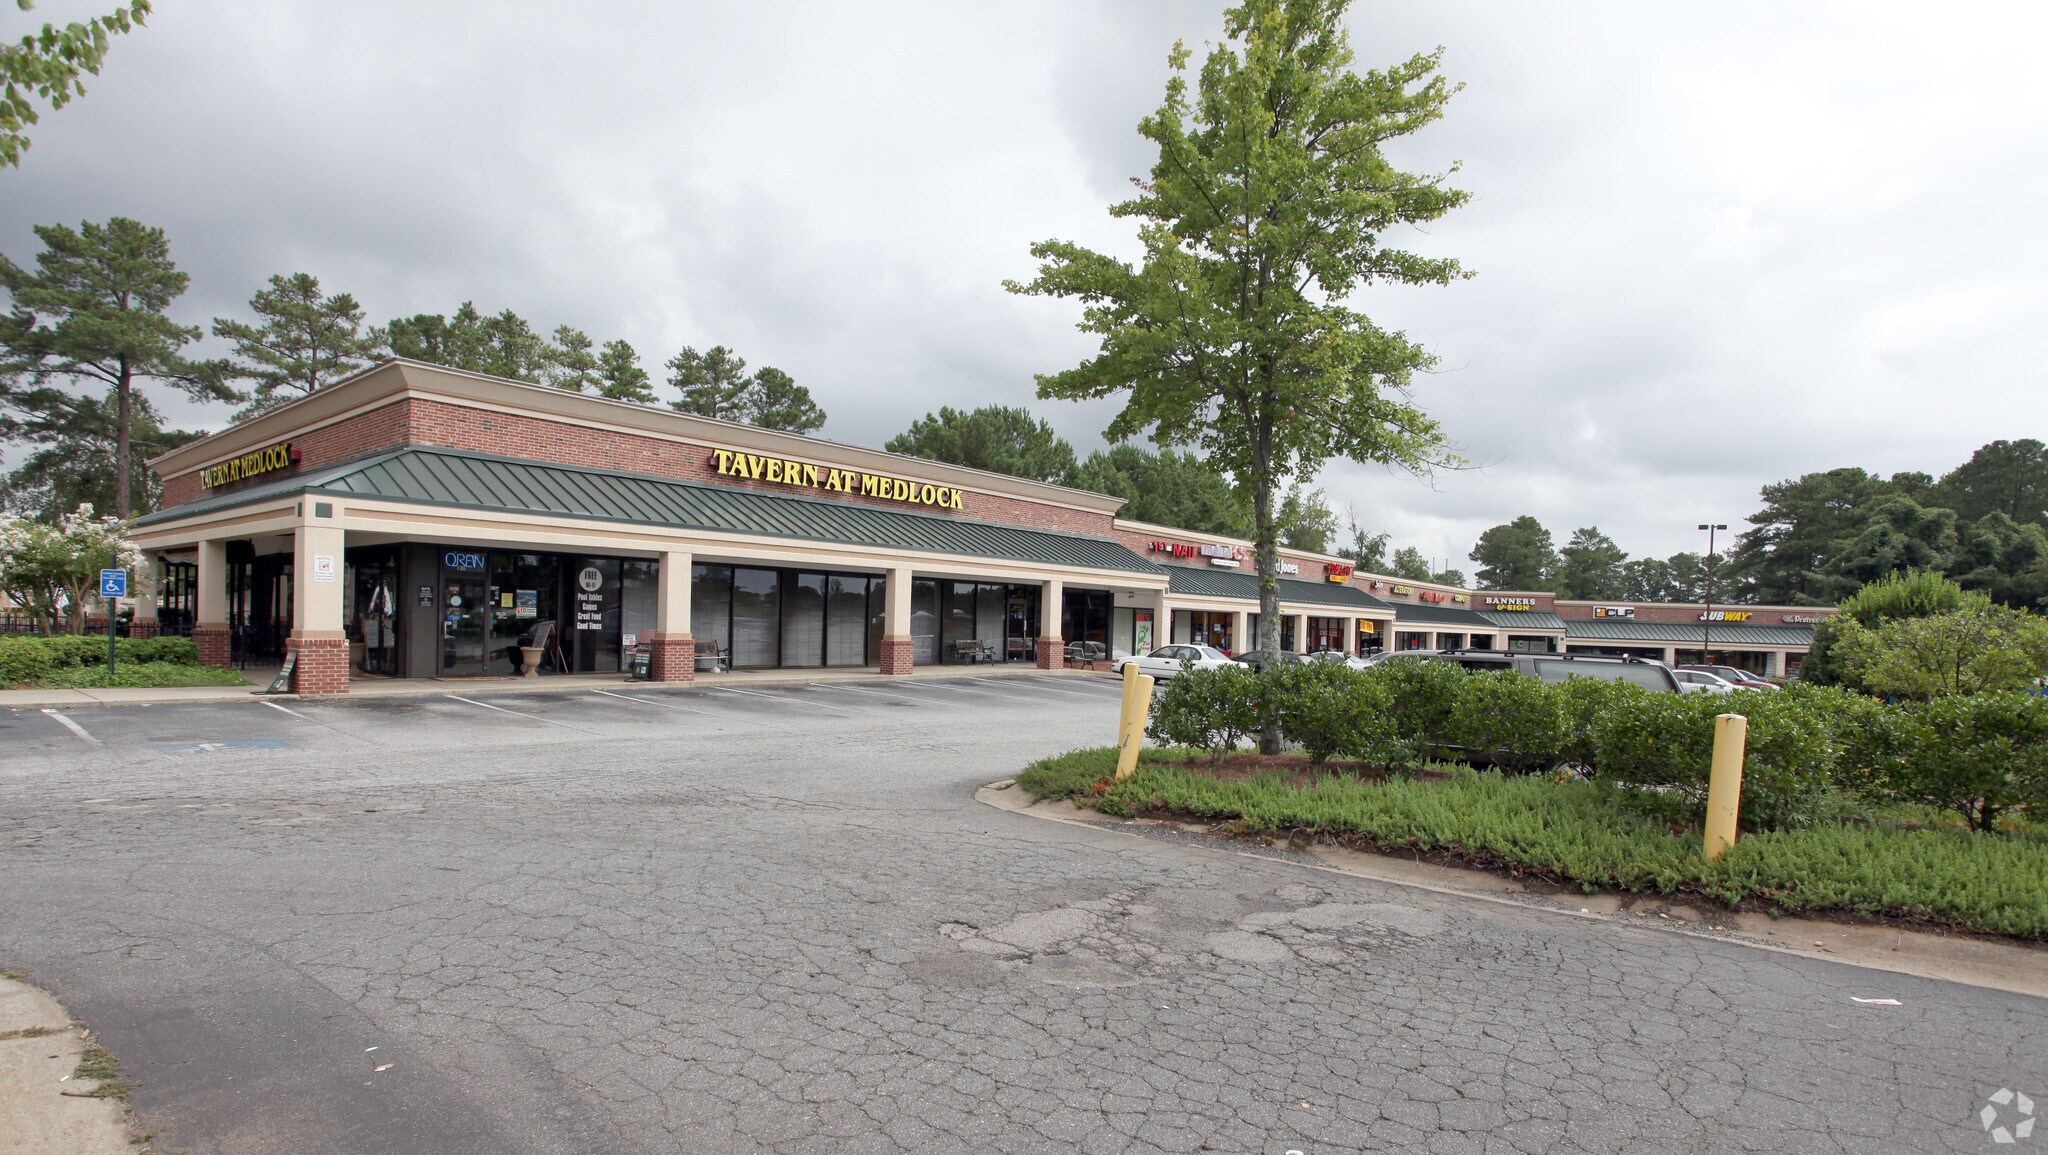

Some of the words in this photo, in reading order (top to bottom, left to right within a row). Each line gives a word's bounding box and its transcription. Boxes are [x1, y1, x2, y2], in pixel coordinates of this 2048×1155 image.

[201, 463, 230, 490] TAVERN
[230, 459, 240, 481] AT
[241, 443, 289, 478] MEDLOCK
[713, 449, 819, 488] TAVERN
[824, 468, 856, 493] AT
[860, 473, 964, 510] MEDLOCK
[584, 570, 598, 580] FREE
[577, 593, 588, 601] Pool
[588, 593, 603, 601] Tables
[1485, 597, 1536, 606] BANNERS
[582, 602, 598, 610] Games
[577, 612, 591, 620] Great
[591, 612, 602, 620] Food
[1607, 608, 1635, 617] CLP
[1700, 611, 1752, 621] SUBWAY
[576, 621, 589, 630] Good
[589, 621, 602, 630] Times
